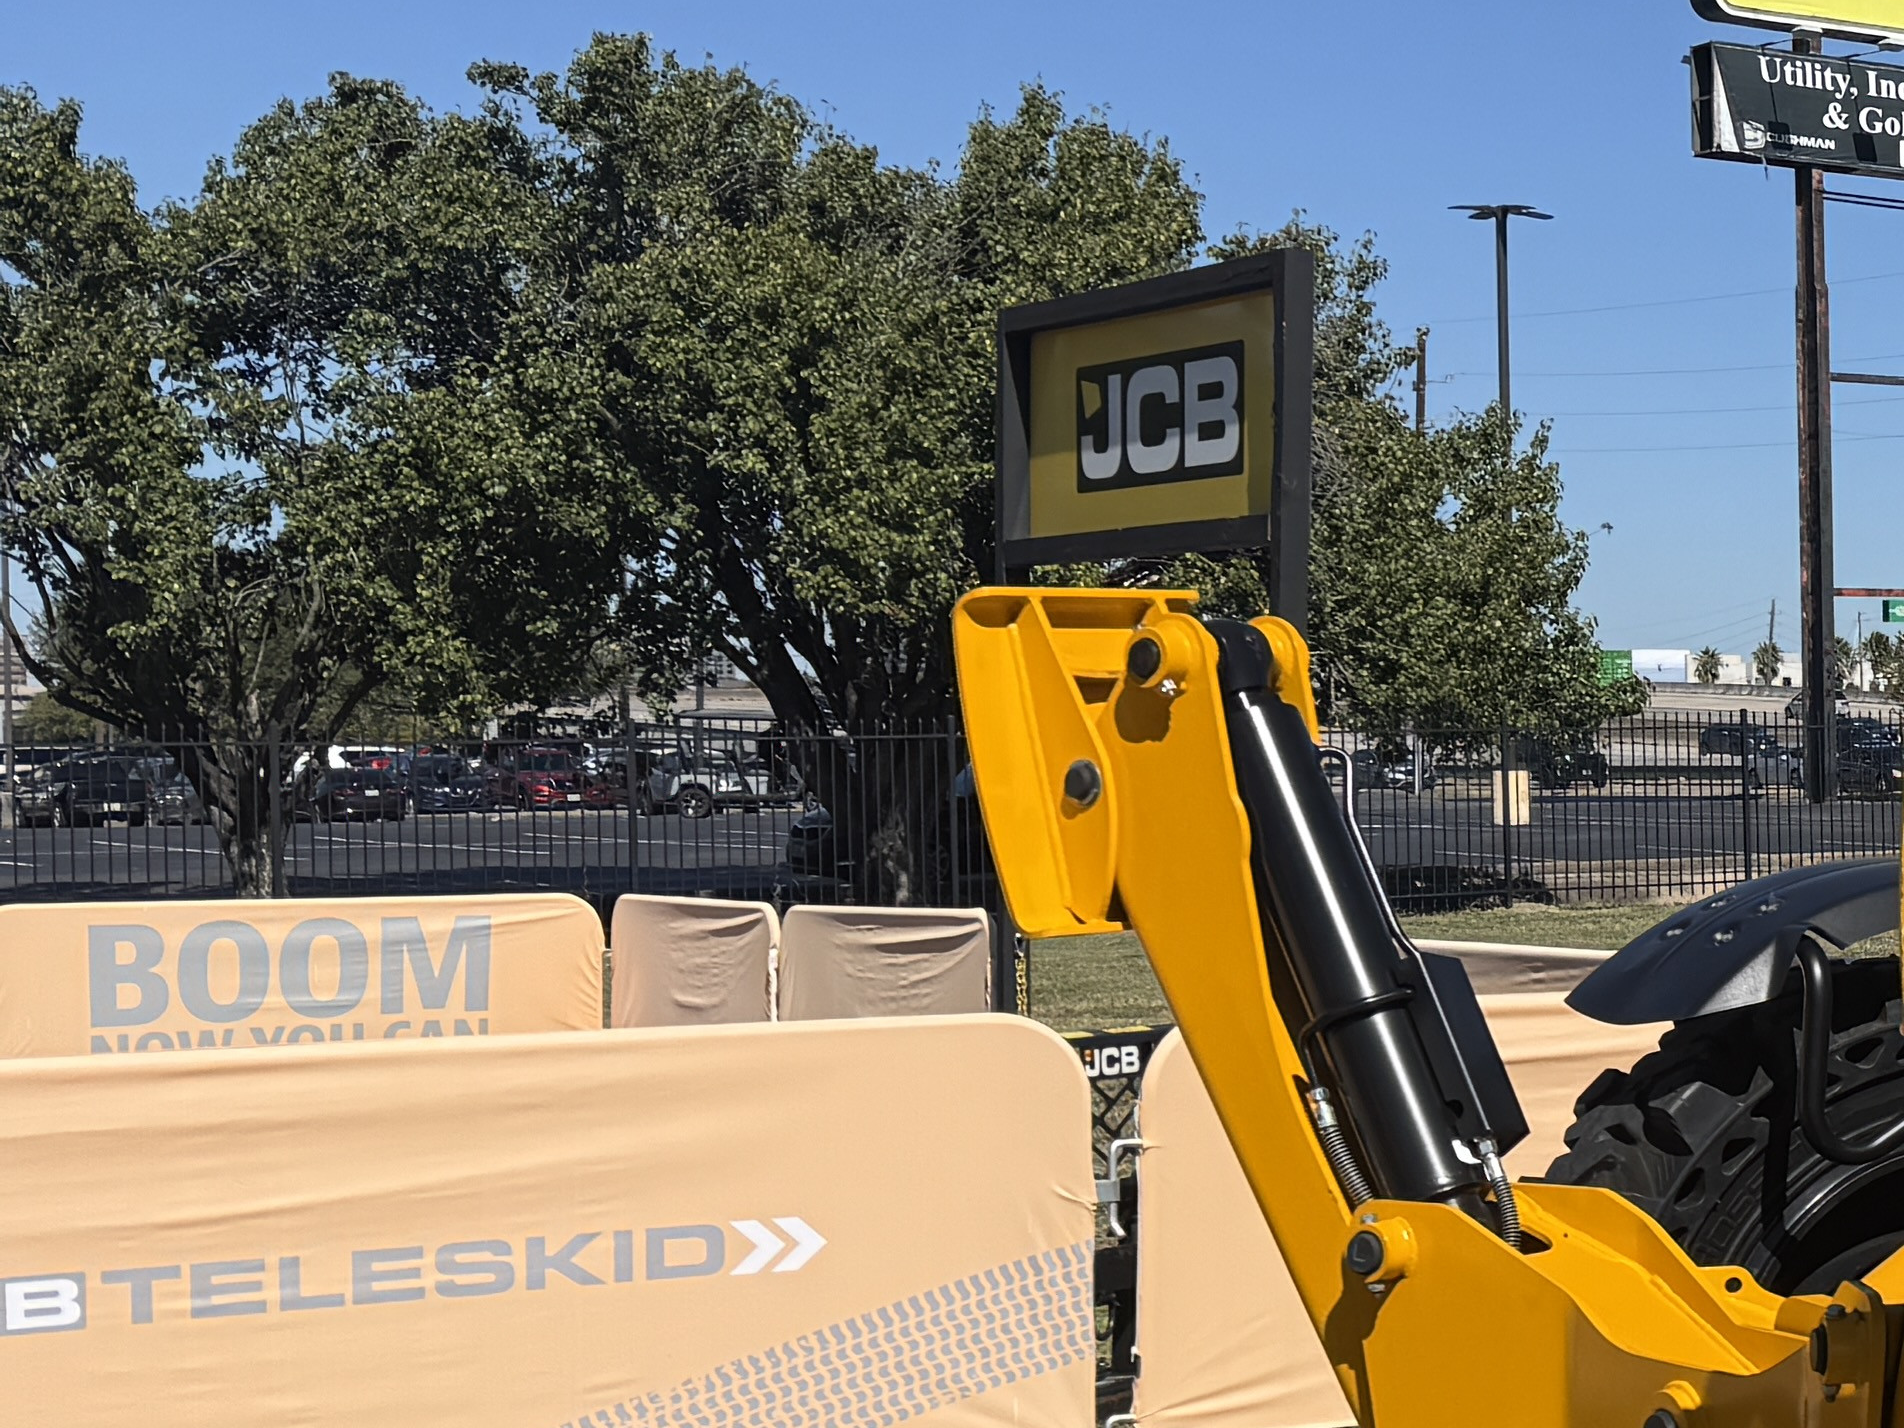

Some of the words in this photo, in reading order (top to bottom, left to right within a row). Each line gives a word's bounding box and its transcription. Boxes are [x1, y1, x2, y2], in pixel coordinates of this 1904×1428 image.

[1757, 55, 1860, 99] Utility,
[1822, 102, 1850, 131] &
[1081, 355, 1240, 481] JCB
[89, 915, 492, 1029] BOOM
[1084, 1044, 1140, 1077] JCB
[100, 1222, 728, 1325] TELESKID
